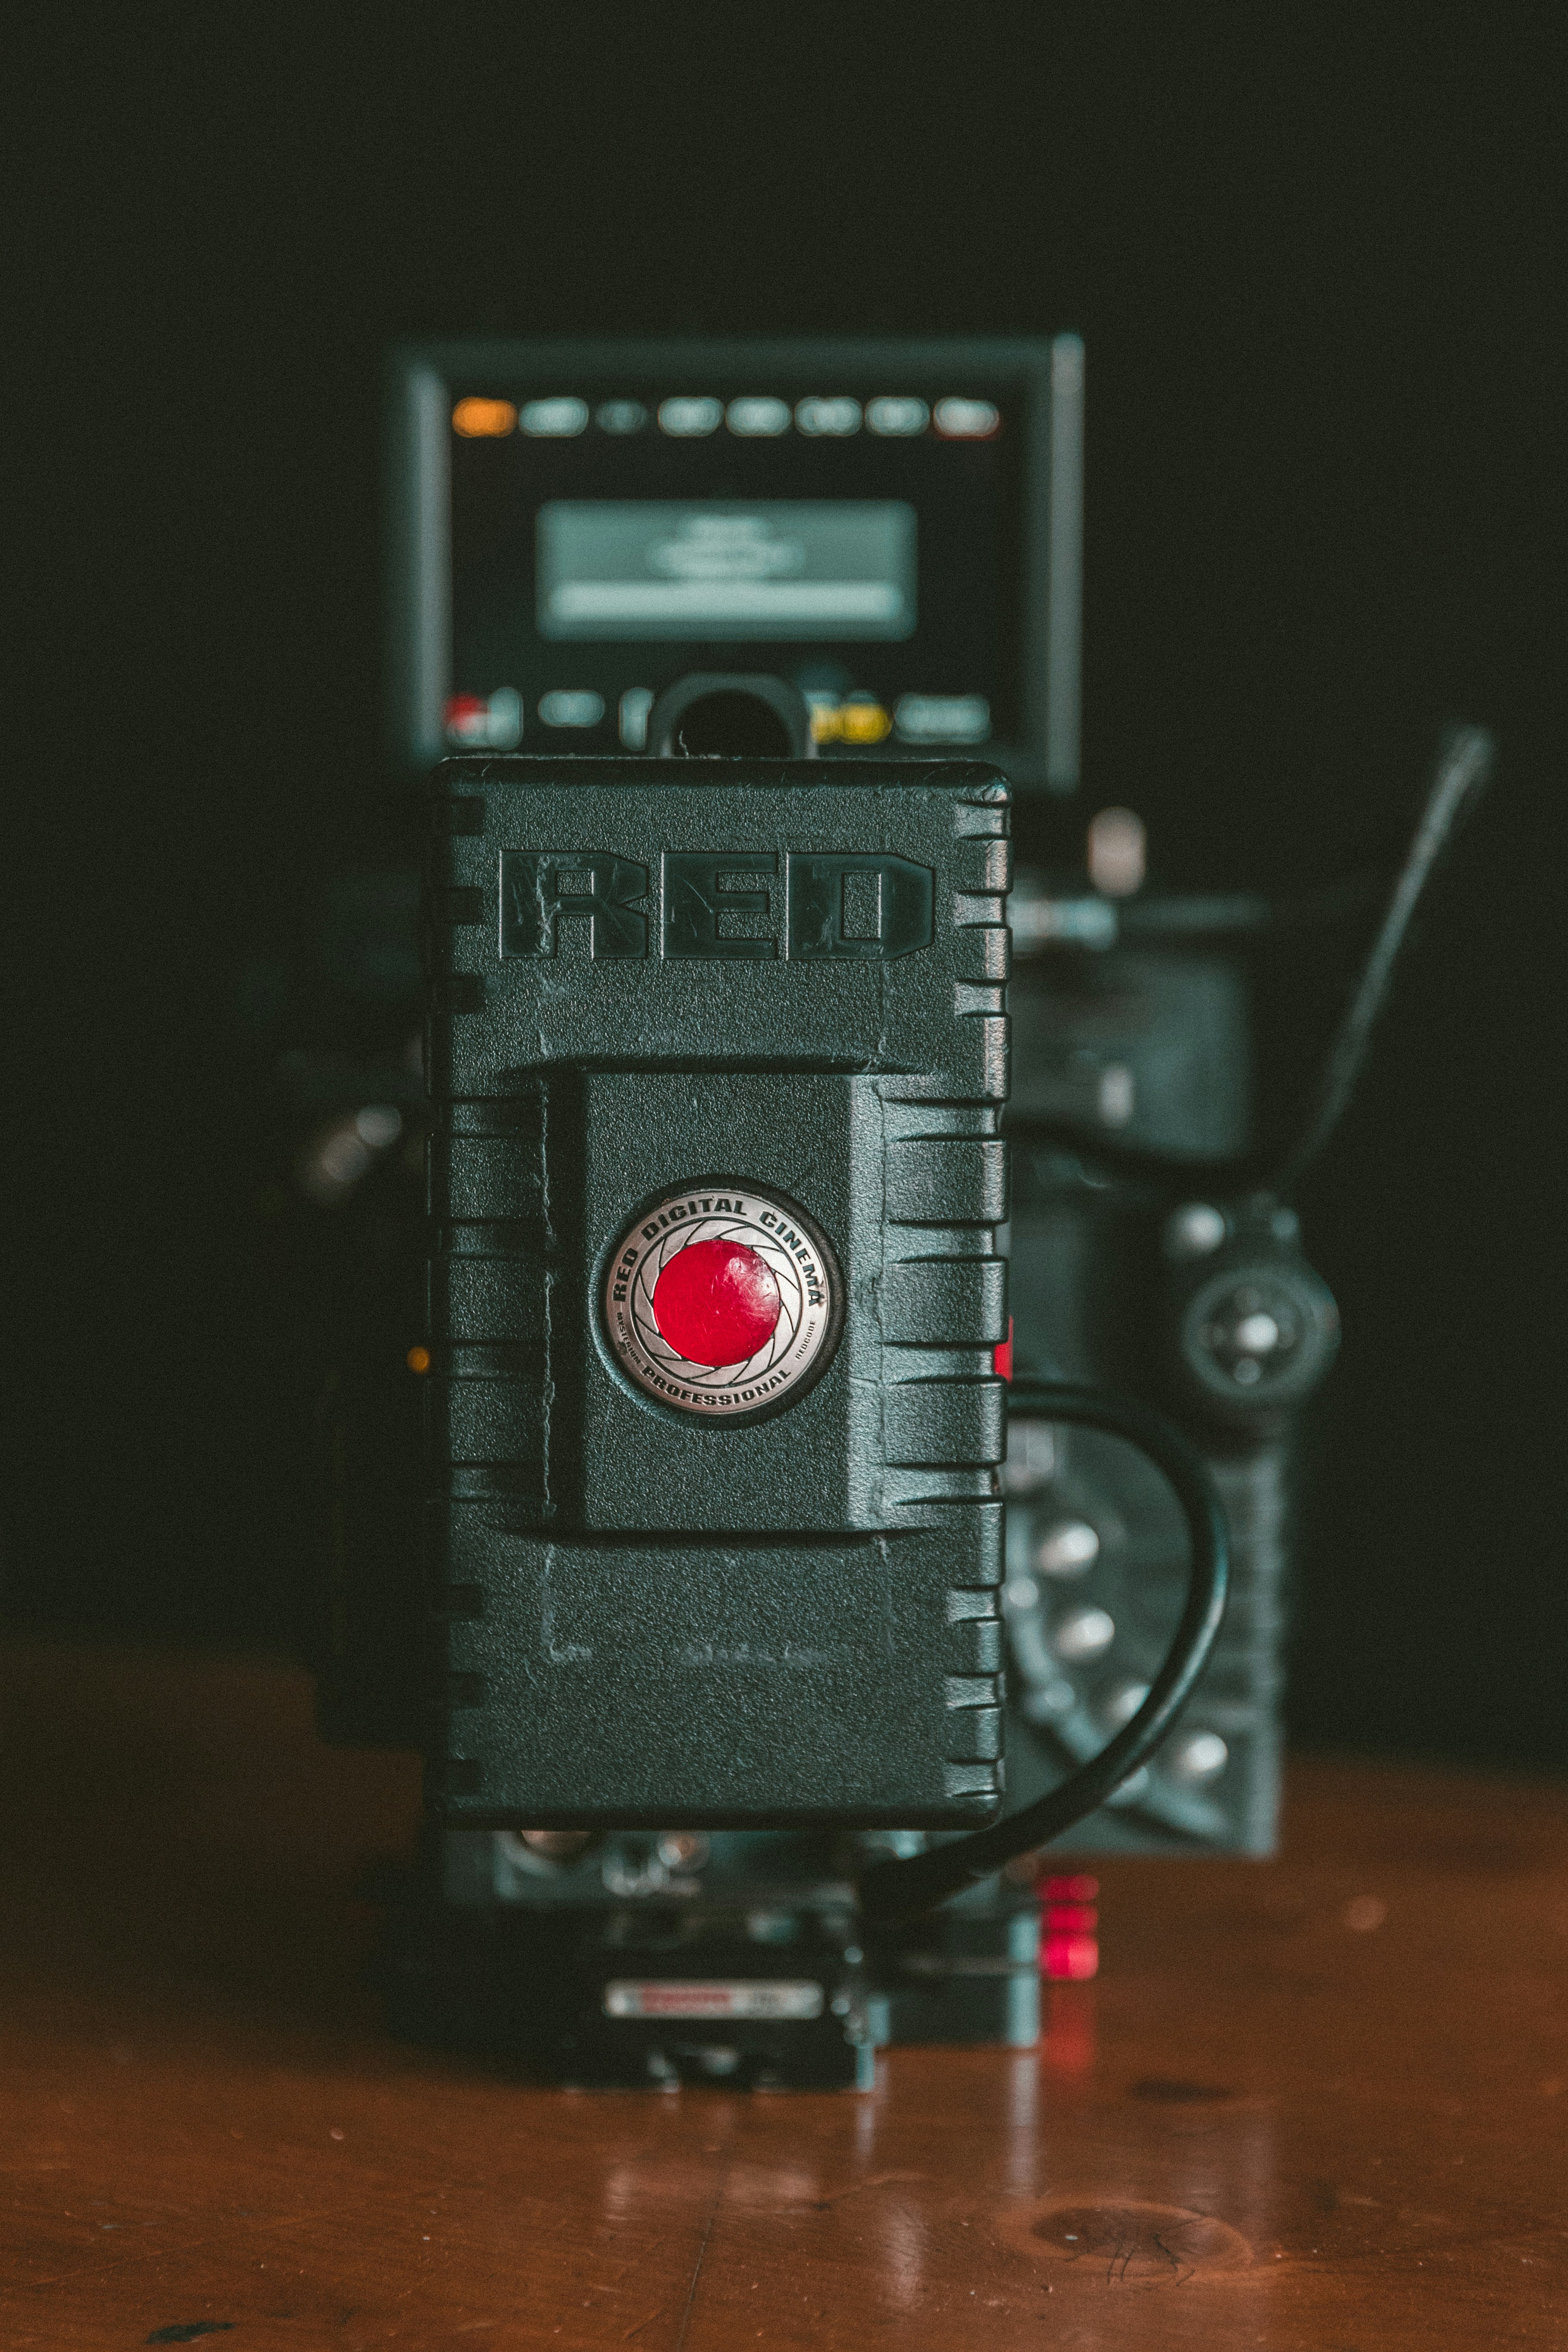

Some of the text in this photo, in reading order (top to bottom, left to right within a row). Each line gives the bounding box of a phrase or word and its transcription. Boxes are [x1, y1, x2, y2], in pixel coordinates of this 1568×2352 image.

[499, 850, 935, 960] RED
[613, 1198, 820, 1307] RED DIGITAL CINEMA
[616, 1312, 640, 1364] MYSTERIUM
[795, 1320, 815, 1360] REDCODE
[642, 1367, 791, 1406] PROFESSIONAL
